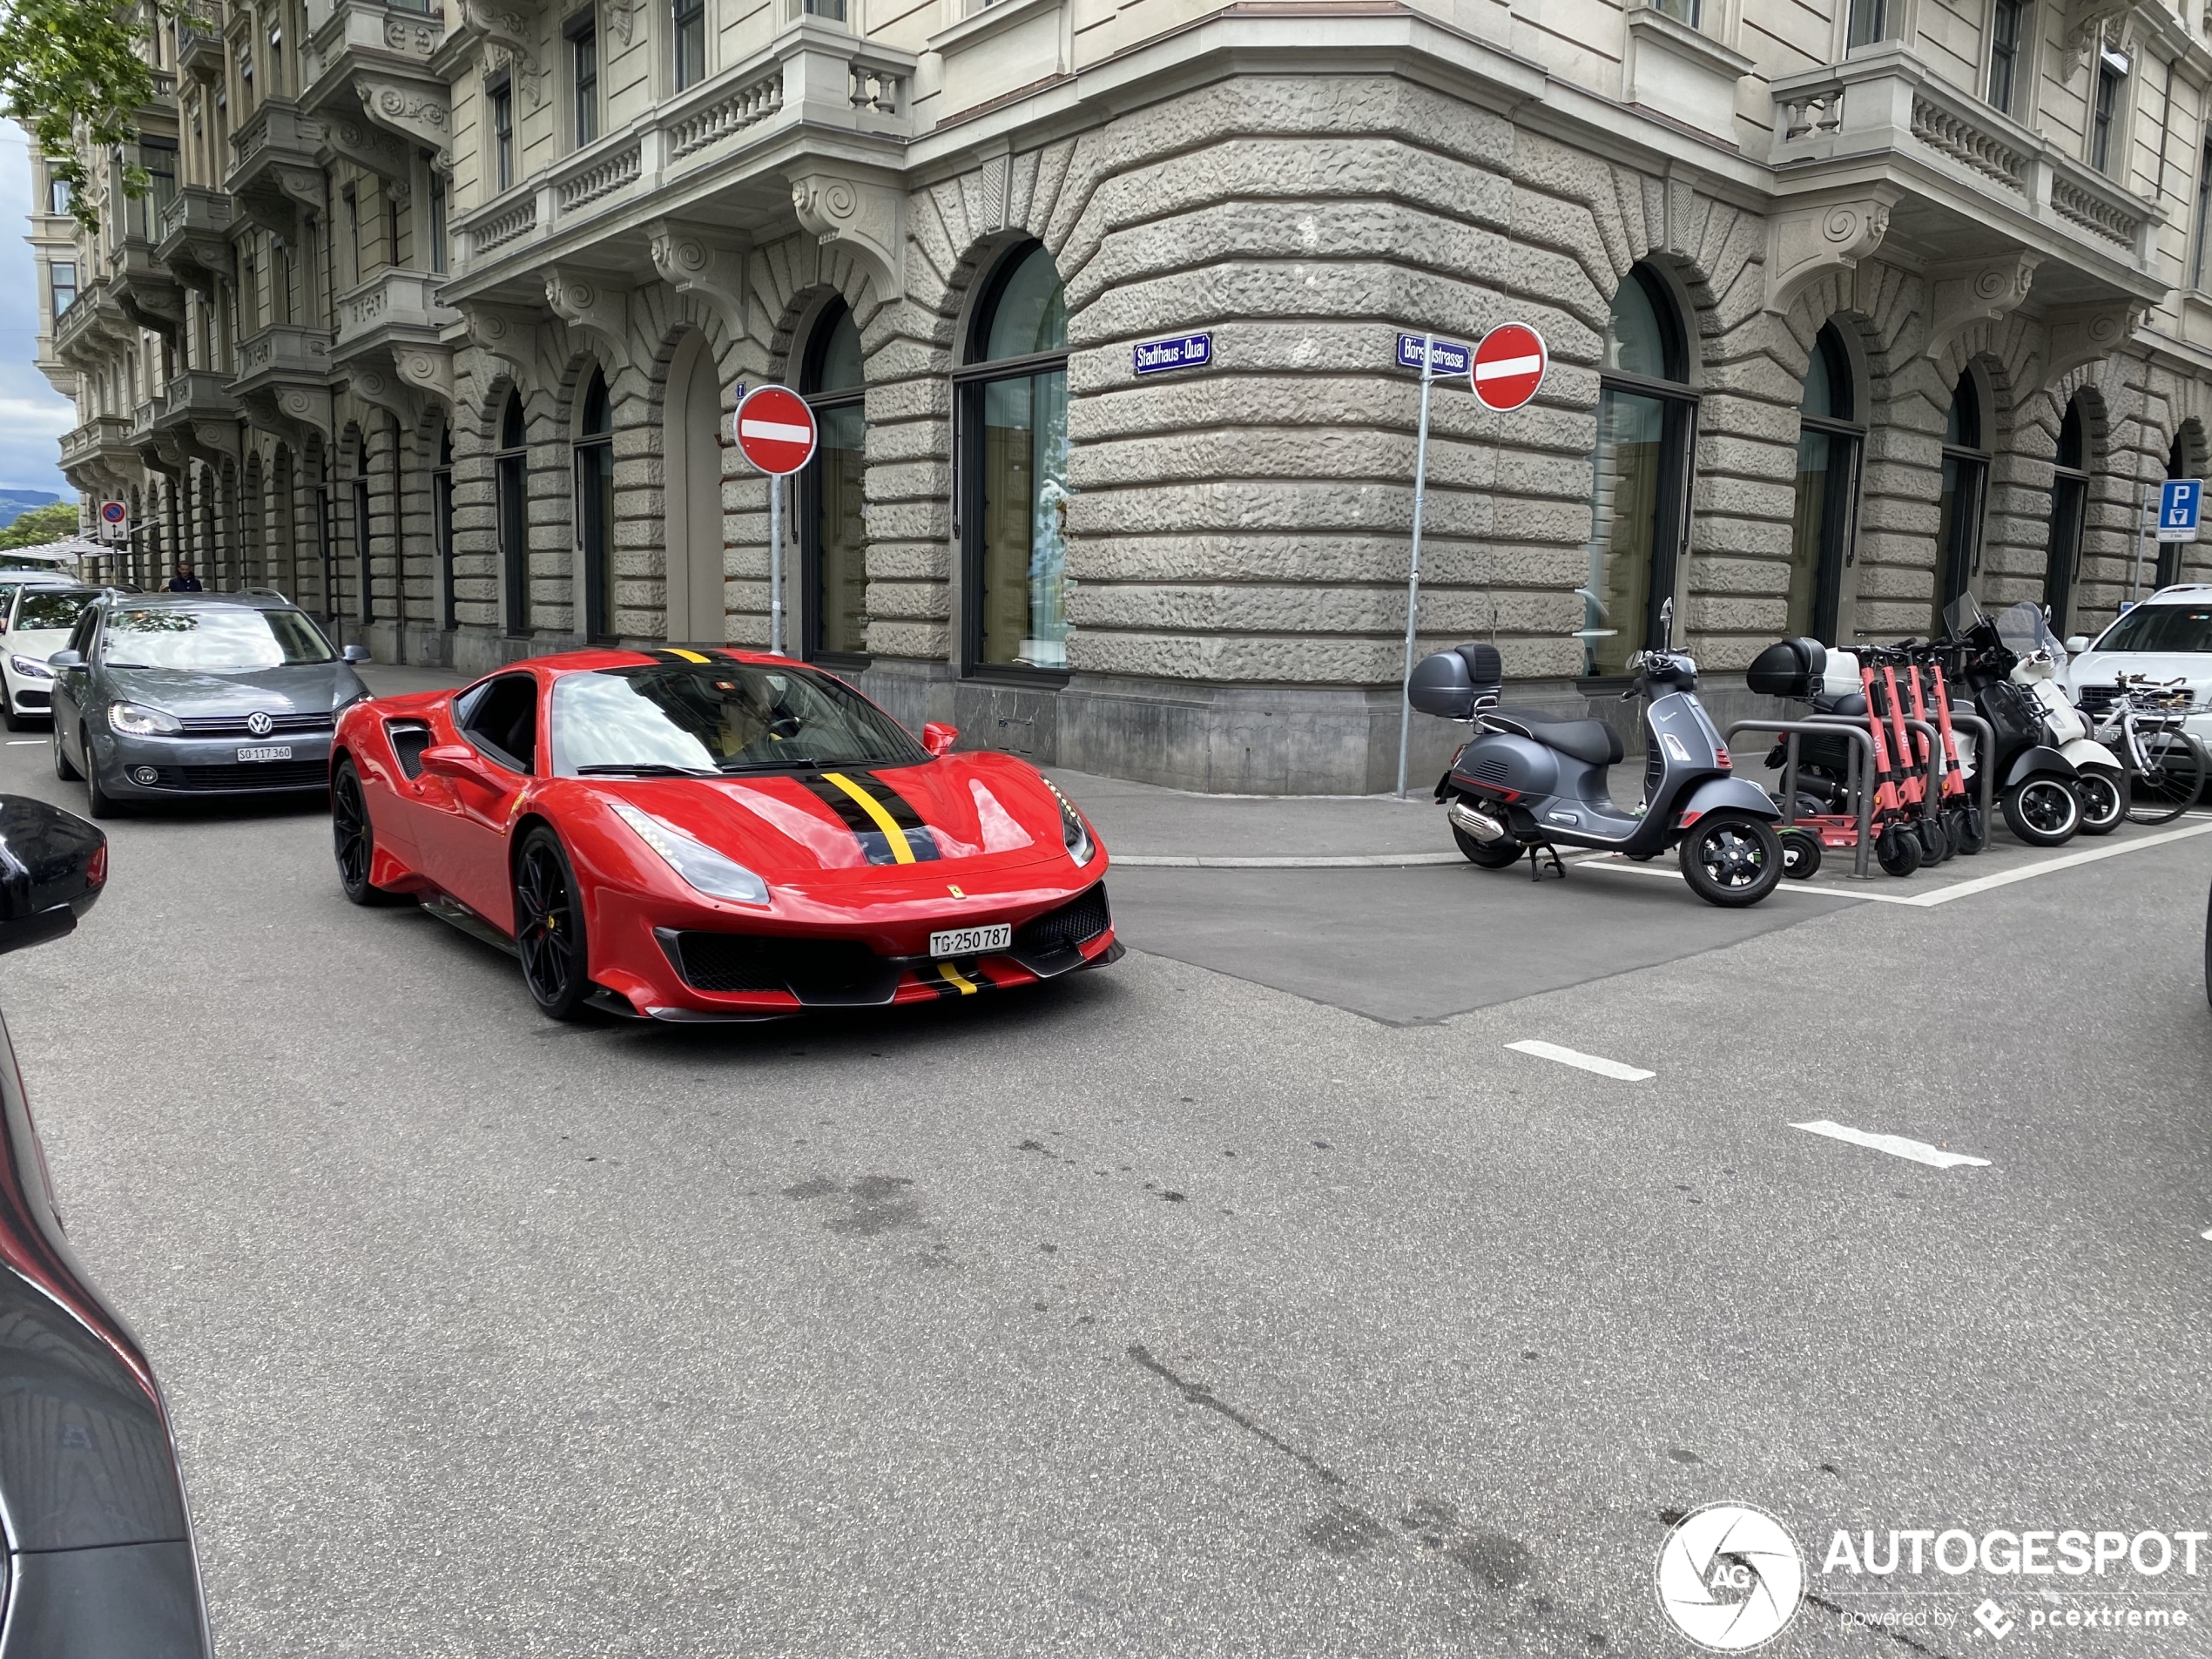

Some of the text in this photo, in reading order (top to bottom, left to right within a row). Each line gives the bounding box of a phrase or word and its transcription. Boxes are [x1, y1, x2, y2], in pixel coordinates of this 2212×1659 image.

[1404, 338, 1464, 368] Börsstrasse
[2173, 485, 2190, 508] P
[983, 927, 1009, 948] 787
